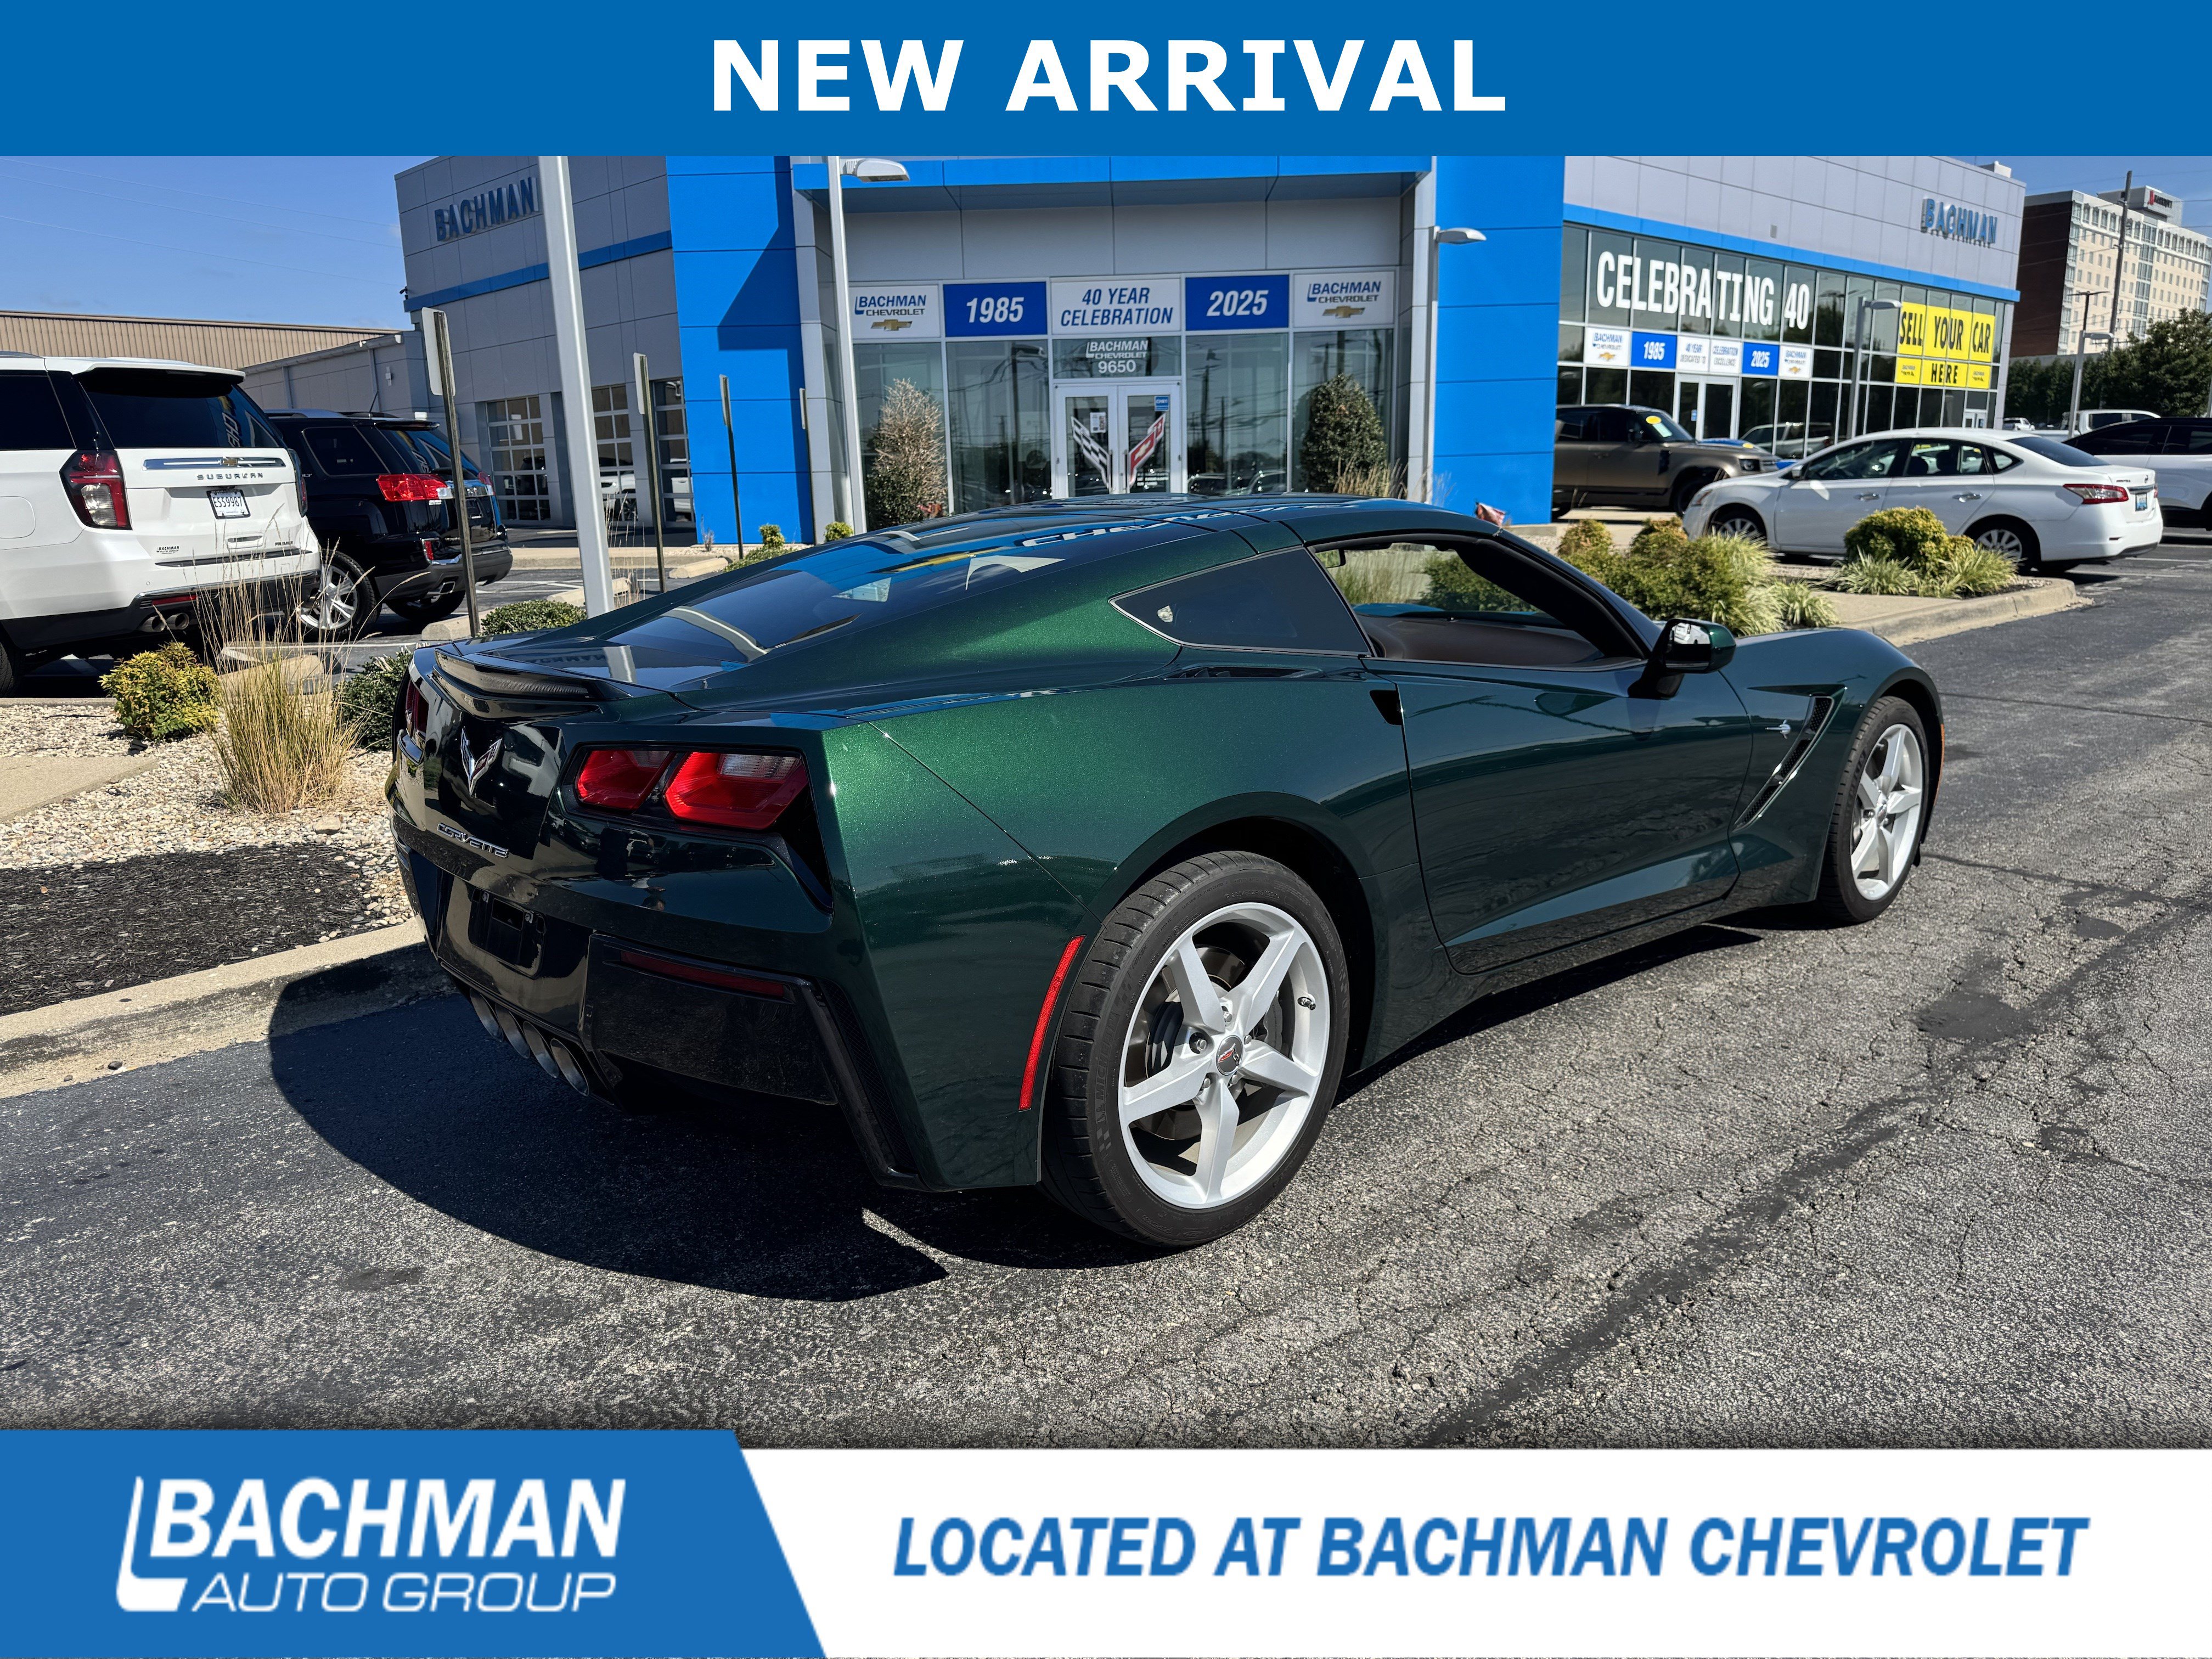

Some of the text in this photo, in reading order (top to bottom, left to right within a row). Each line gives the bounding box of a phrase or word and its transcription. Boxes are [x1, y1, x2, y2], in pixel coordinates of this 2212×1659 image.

[434, 177, 539, 241] BACHMAN
[1924, 198, 1998, 245] BACHMAN
[1082, 287, 1150, 305] 40 YEAR
[1312, 281, 1382, 294] BACHMAN
[1596, 251, 1810, 330] CELEBRATING 40
[858, 295, 927, 307] BACHMAN
[1206, 290, 1269, 317] 2025
[1318, 295, 1378, 303] CHEVROLET
[966, 297, 1024, 324] 1985
[1061, 307, 1173, 327] CELEBRATION
[1899, 311, 1991, 354] SELL YOUR CAR
[1089, 340, 1149, 352] BACHMAN
[1643, 341, 1665, 361] 1985
[1098, 359, 1136, 374] 9650
[1751, 350, 1770, 368] 2025
[1931, 363, 1958, 384] HERE
[437, 823, 509, 858] CORVETTE
